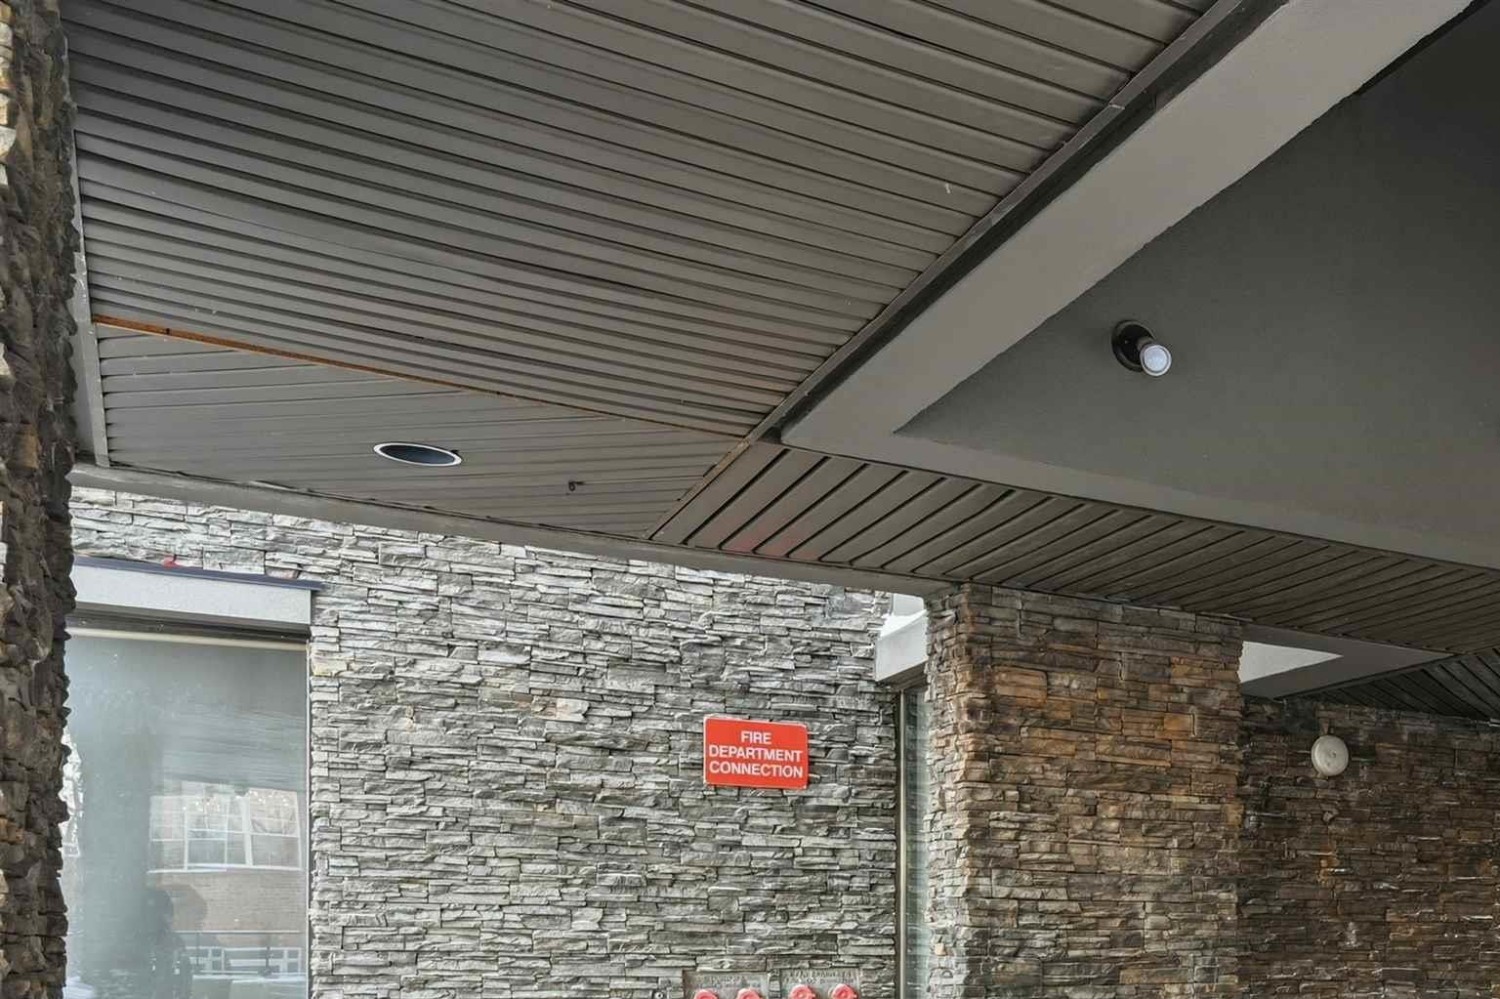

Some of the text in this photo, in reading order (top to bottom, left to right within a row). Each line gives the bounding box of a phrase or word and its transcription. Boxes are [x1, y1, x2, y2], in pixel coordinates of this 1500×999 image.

[740, 731, 772, 745] FIRE
[708, 745, 803, 762] DEPARTMENT
[709, 761, 803, 778] CONNECTION
